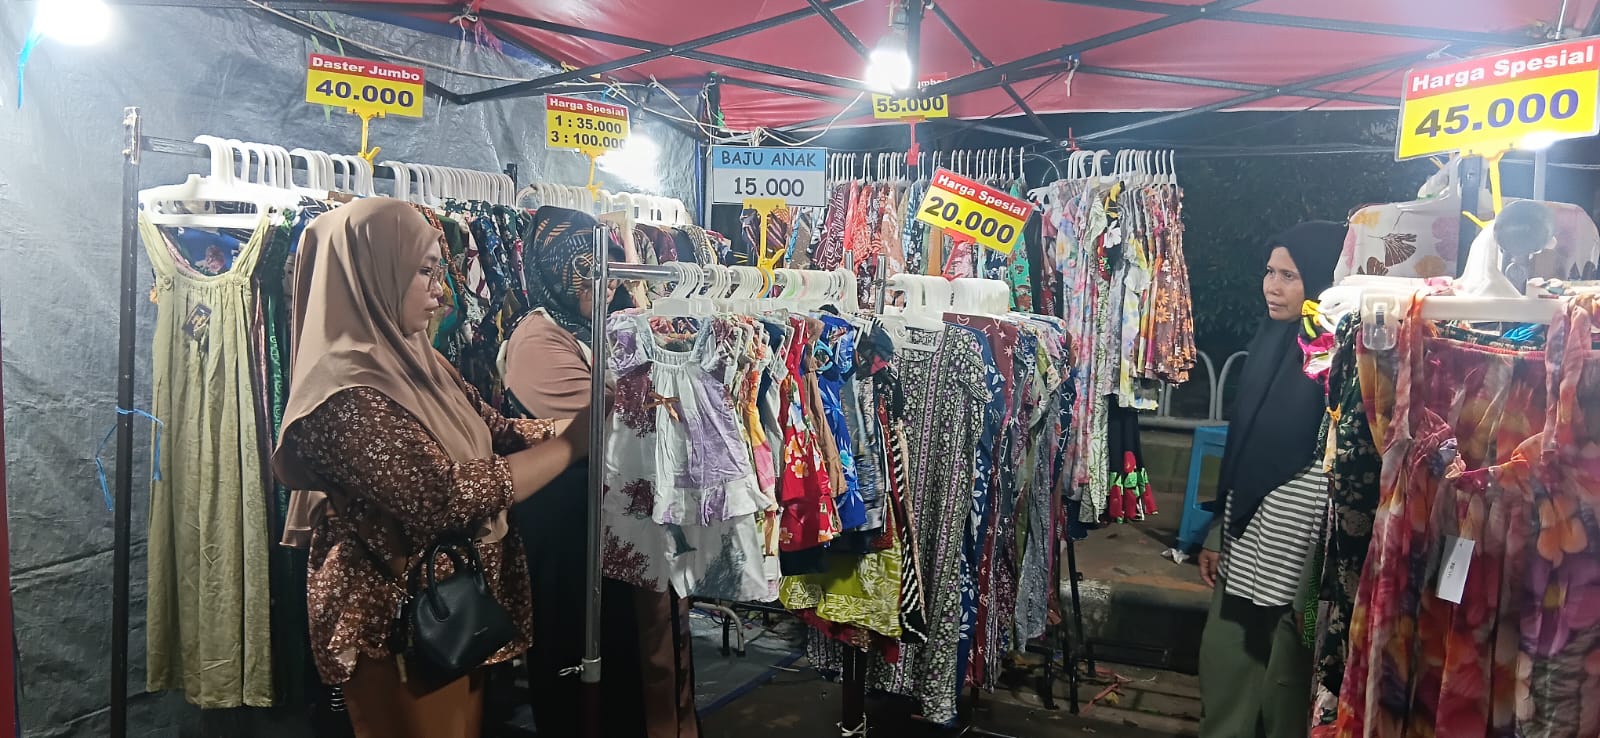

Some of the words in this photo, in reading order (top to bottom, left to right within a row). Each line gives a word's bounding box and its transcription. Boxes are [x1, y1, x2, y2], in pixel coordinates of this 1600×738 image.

[312, 57, 365, 74] Daster
[368, 65, 420, 81] Jumbo
[1412, 67, 1485, 92] Harga
[1493, 45, 1594, 78] Spesial
[316, 79, 414, 107] 40.000
[550, 98, 583, 110] Harga
[587, 103, 624, 117] Spesial
[877, 97, 944, 112] 55.000
[1415, 89, 1579, 138] 45.000
[555, 115, 562, 126] 1
[577, 117, 621, 134] 35.000
[551, 131, 559, 142] 3
[721, 151, 763, 166] BAJU
[771, 151, 817, 167] ANAK
[734, 177, 804, 197] 15.000
[937, 174, 975, 197] Harga
[977, 188, 1027, 217] Spesial
[924, 196, 1015, 244] 20.000
